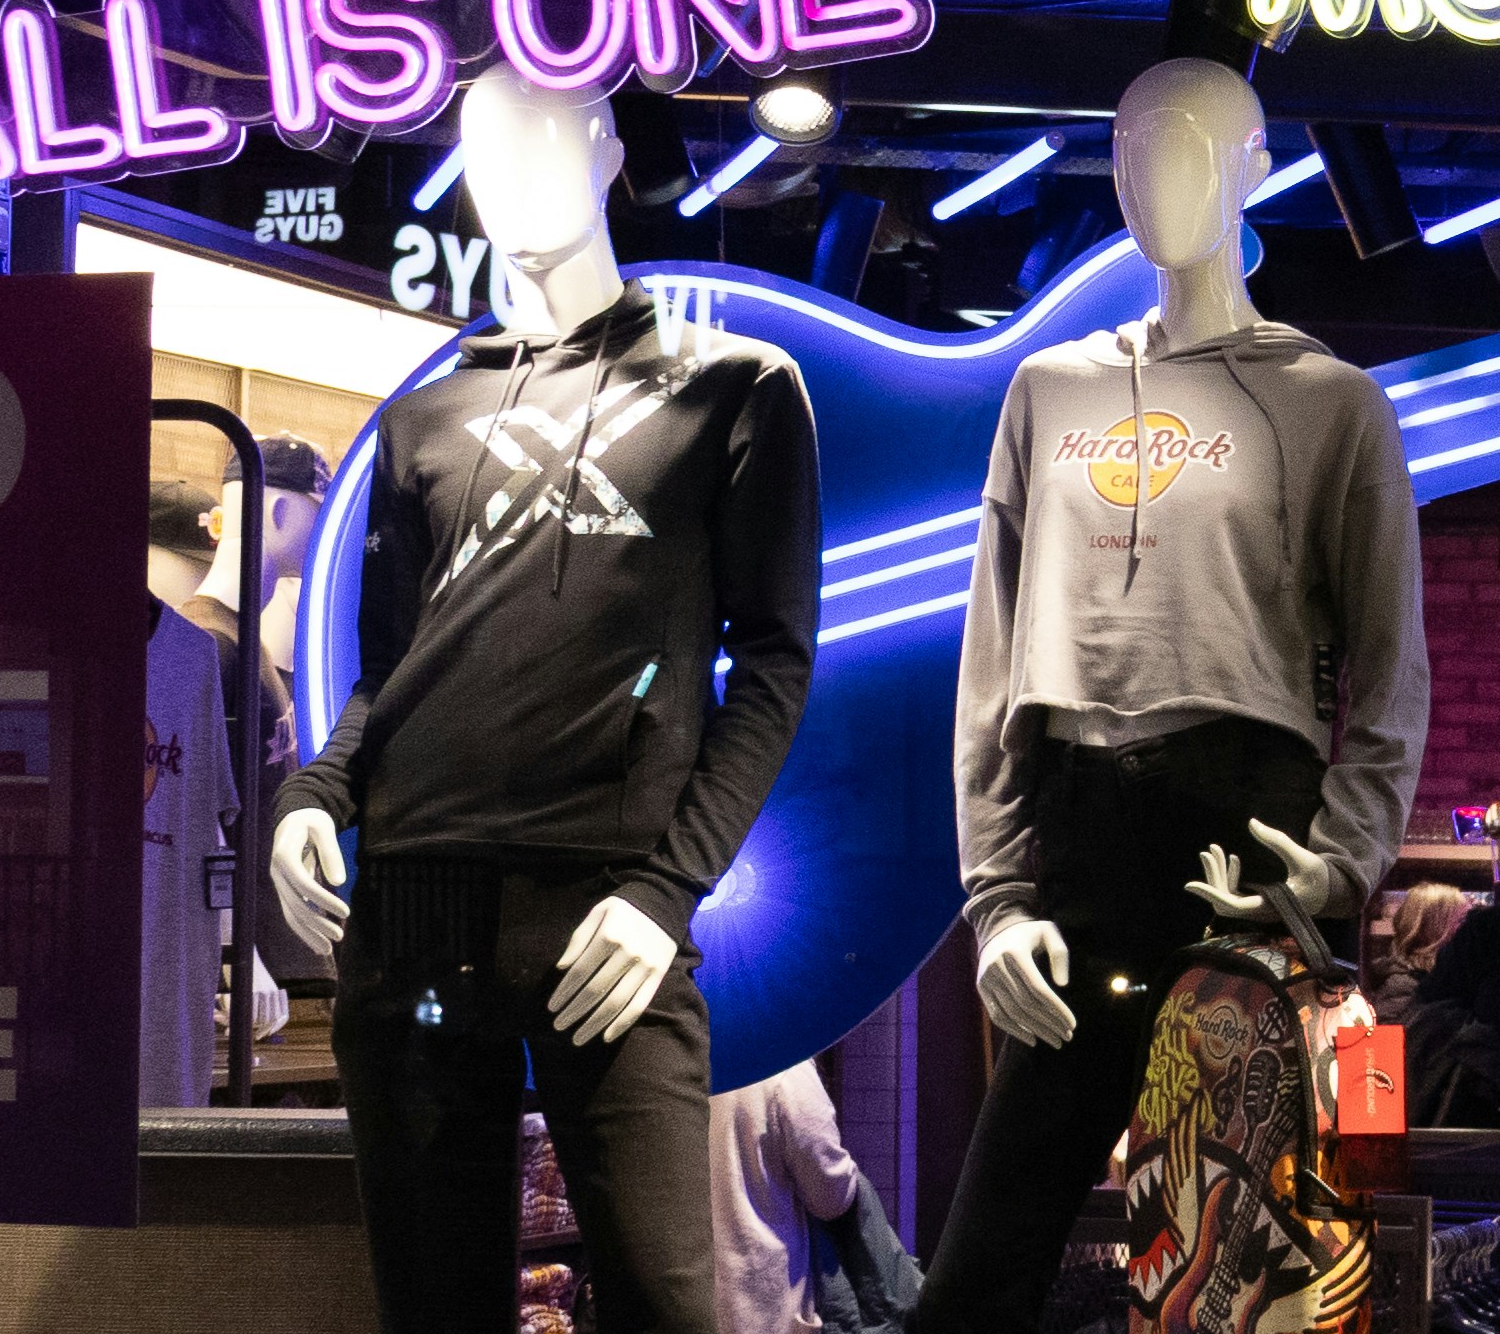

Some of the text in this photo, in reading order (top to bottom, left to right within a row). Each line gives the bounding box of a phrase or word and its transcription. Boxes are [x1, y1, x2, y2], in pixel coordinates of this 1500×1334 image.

[1149, 429, 1232, 468] Rock
[1111, 474, 1155, 488] CAE
[1090, 535, 1157, 549] LONDN
